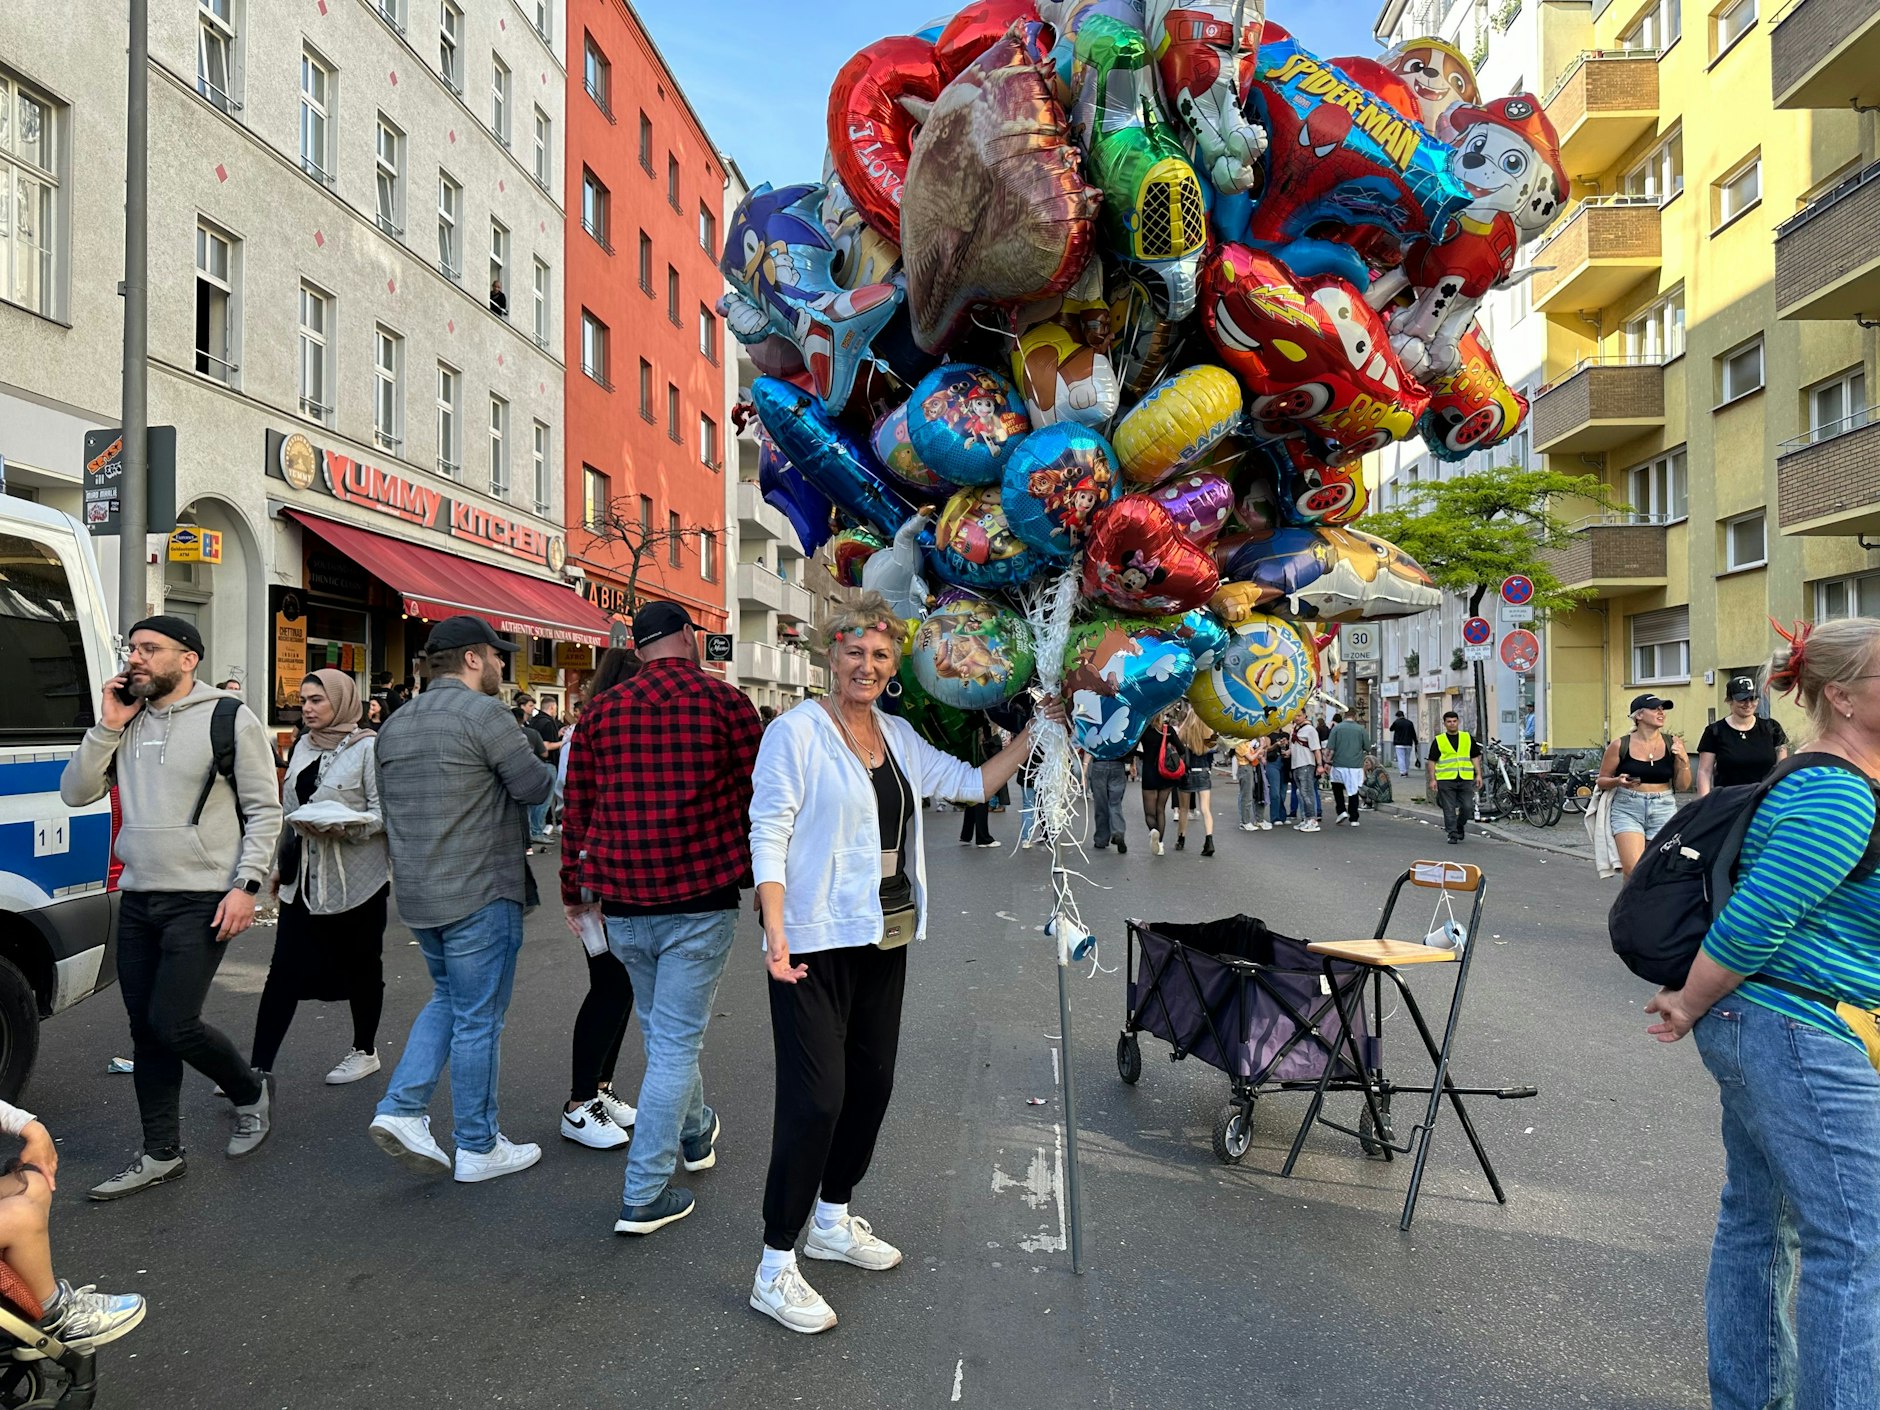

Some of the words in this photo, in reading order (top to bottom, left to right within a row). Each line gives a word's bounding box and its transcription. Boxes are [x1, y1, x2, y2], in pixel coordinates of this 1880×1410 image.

[1265, 54, 1421, 171] SPIDER-MAN
[288, 468, 312, 483] YUMMY
[323, 449, 441, 528] YUMMY
[451, 499, 547, 557] KITCHEN
[501, 620, 534, 636] AUTHENTIC
[534, 626, 554, 639] SOUTH
[553, 629, 572, 641] INDIAN
[571, 633, 602, 646] RESTAURANT
[1352, 633, 1368, 645] 30
[1350, 651, 1371, 660] ZONE
[38, 826, 62, 847] 11
